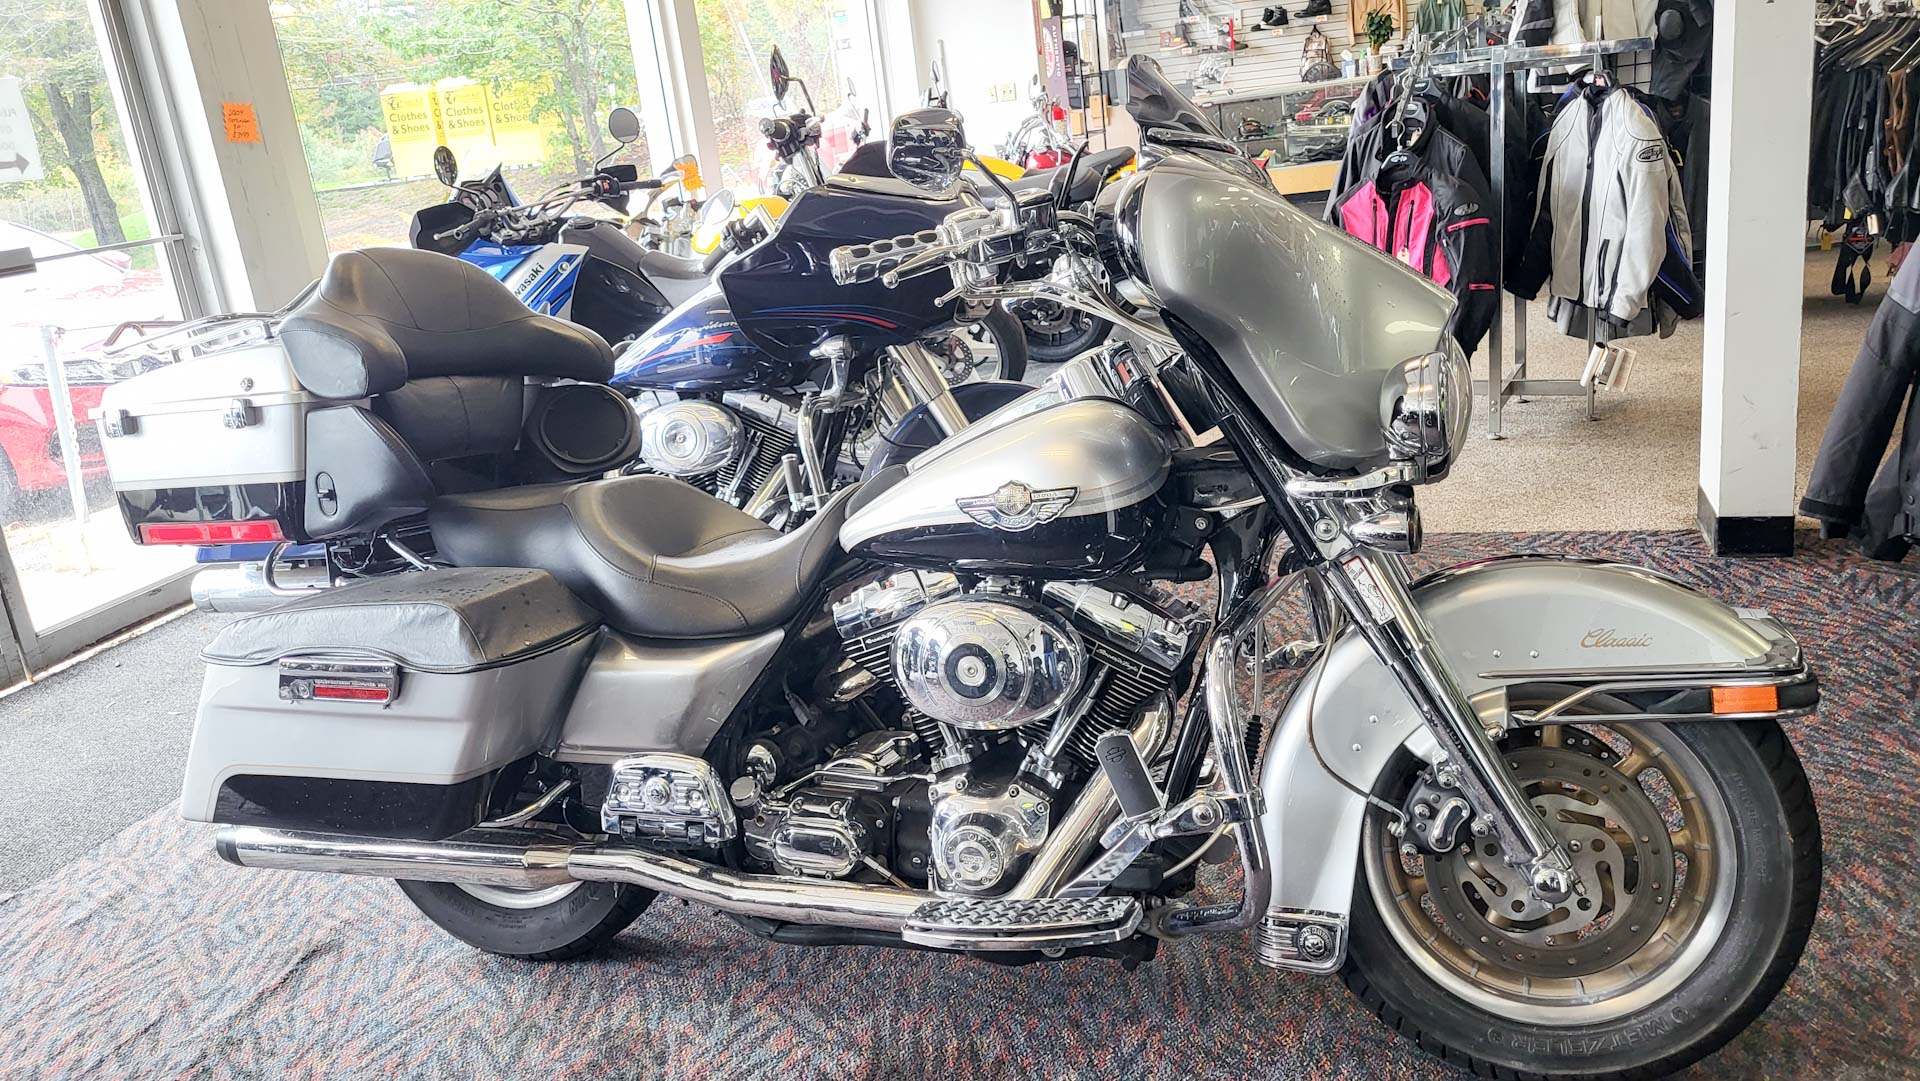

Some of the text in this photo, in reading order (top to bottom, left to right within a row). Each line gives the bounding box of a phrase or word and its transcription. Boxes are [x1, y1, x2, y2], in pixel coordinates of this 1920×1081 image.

[445, 105, 483, 117] Clothes
[389, 112, 428, 122] Clothes
[503, 113, 529, 122] Shoe
[392, 123, 431, 134] & Shoes
[449, 118, 485, 129] & Shoes
[514, 262, 545, 297] wasaki
[1581, 628, 1653, 648] Classic
[1511, 1016, 1670, 1056] METZELER
